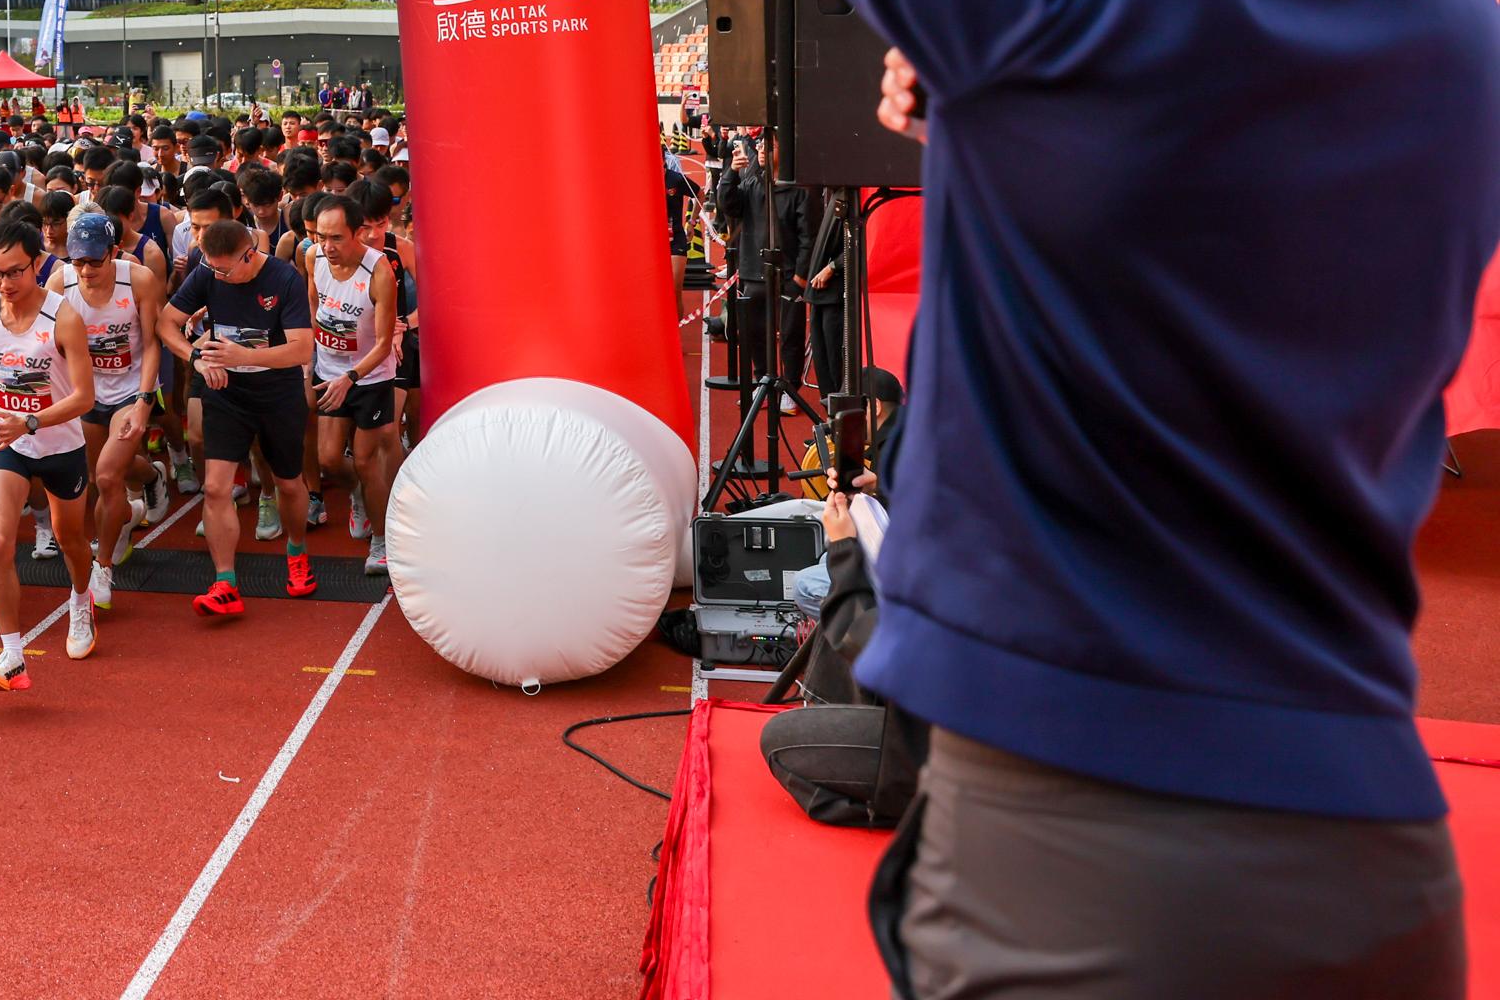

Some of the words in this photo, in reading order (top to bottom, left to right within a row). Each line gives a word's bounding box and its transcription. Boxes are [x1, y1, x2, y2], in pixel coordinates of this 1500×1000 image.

[490, 7, 515, 22] KAI
[519, 4, 547, 19] TAK
[436, 9, 487, 43] 啟德
[491, 20, 548, 37] SPORTS
[553, 17, 588, 33] PARK
[319, 332, 348, 350] 1125
[2, 394, 41, 411] 1045
